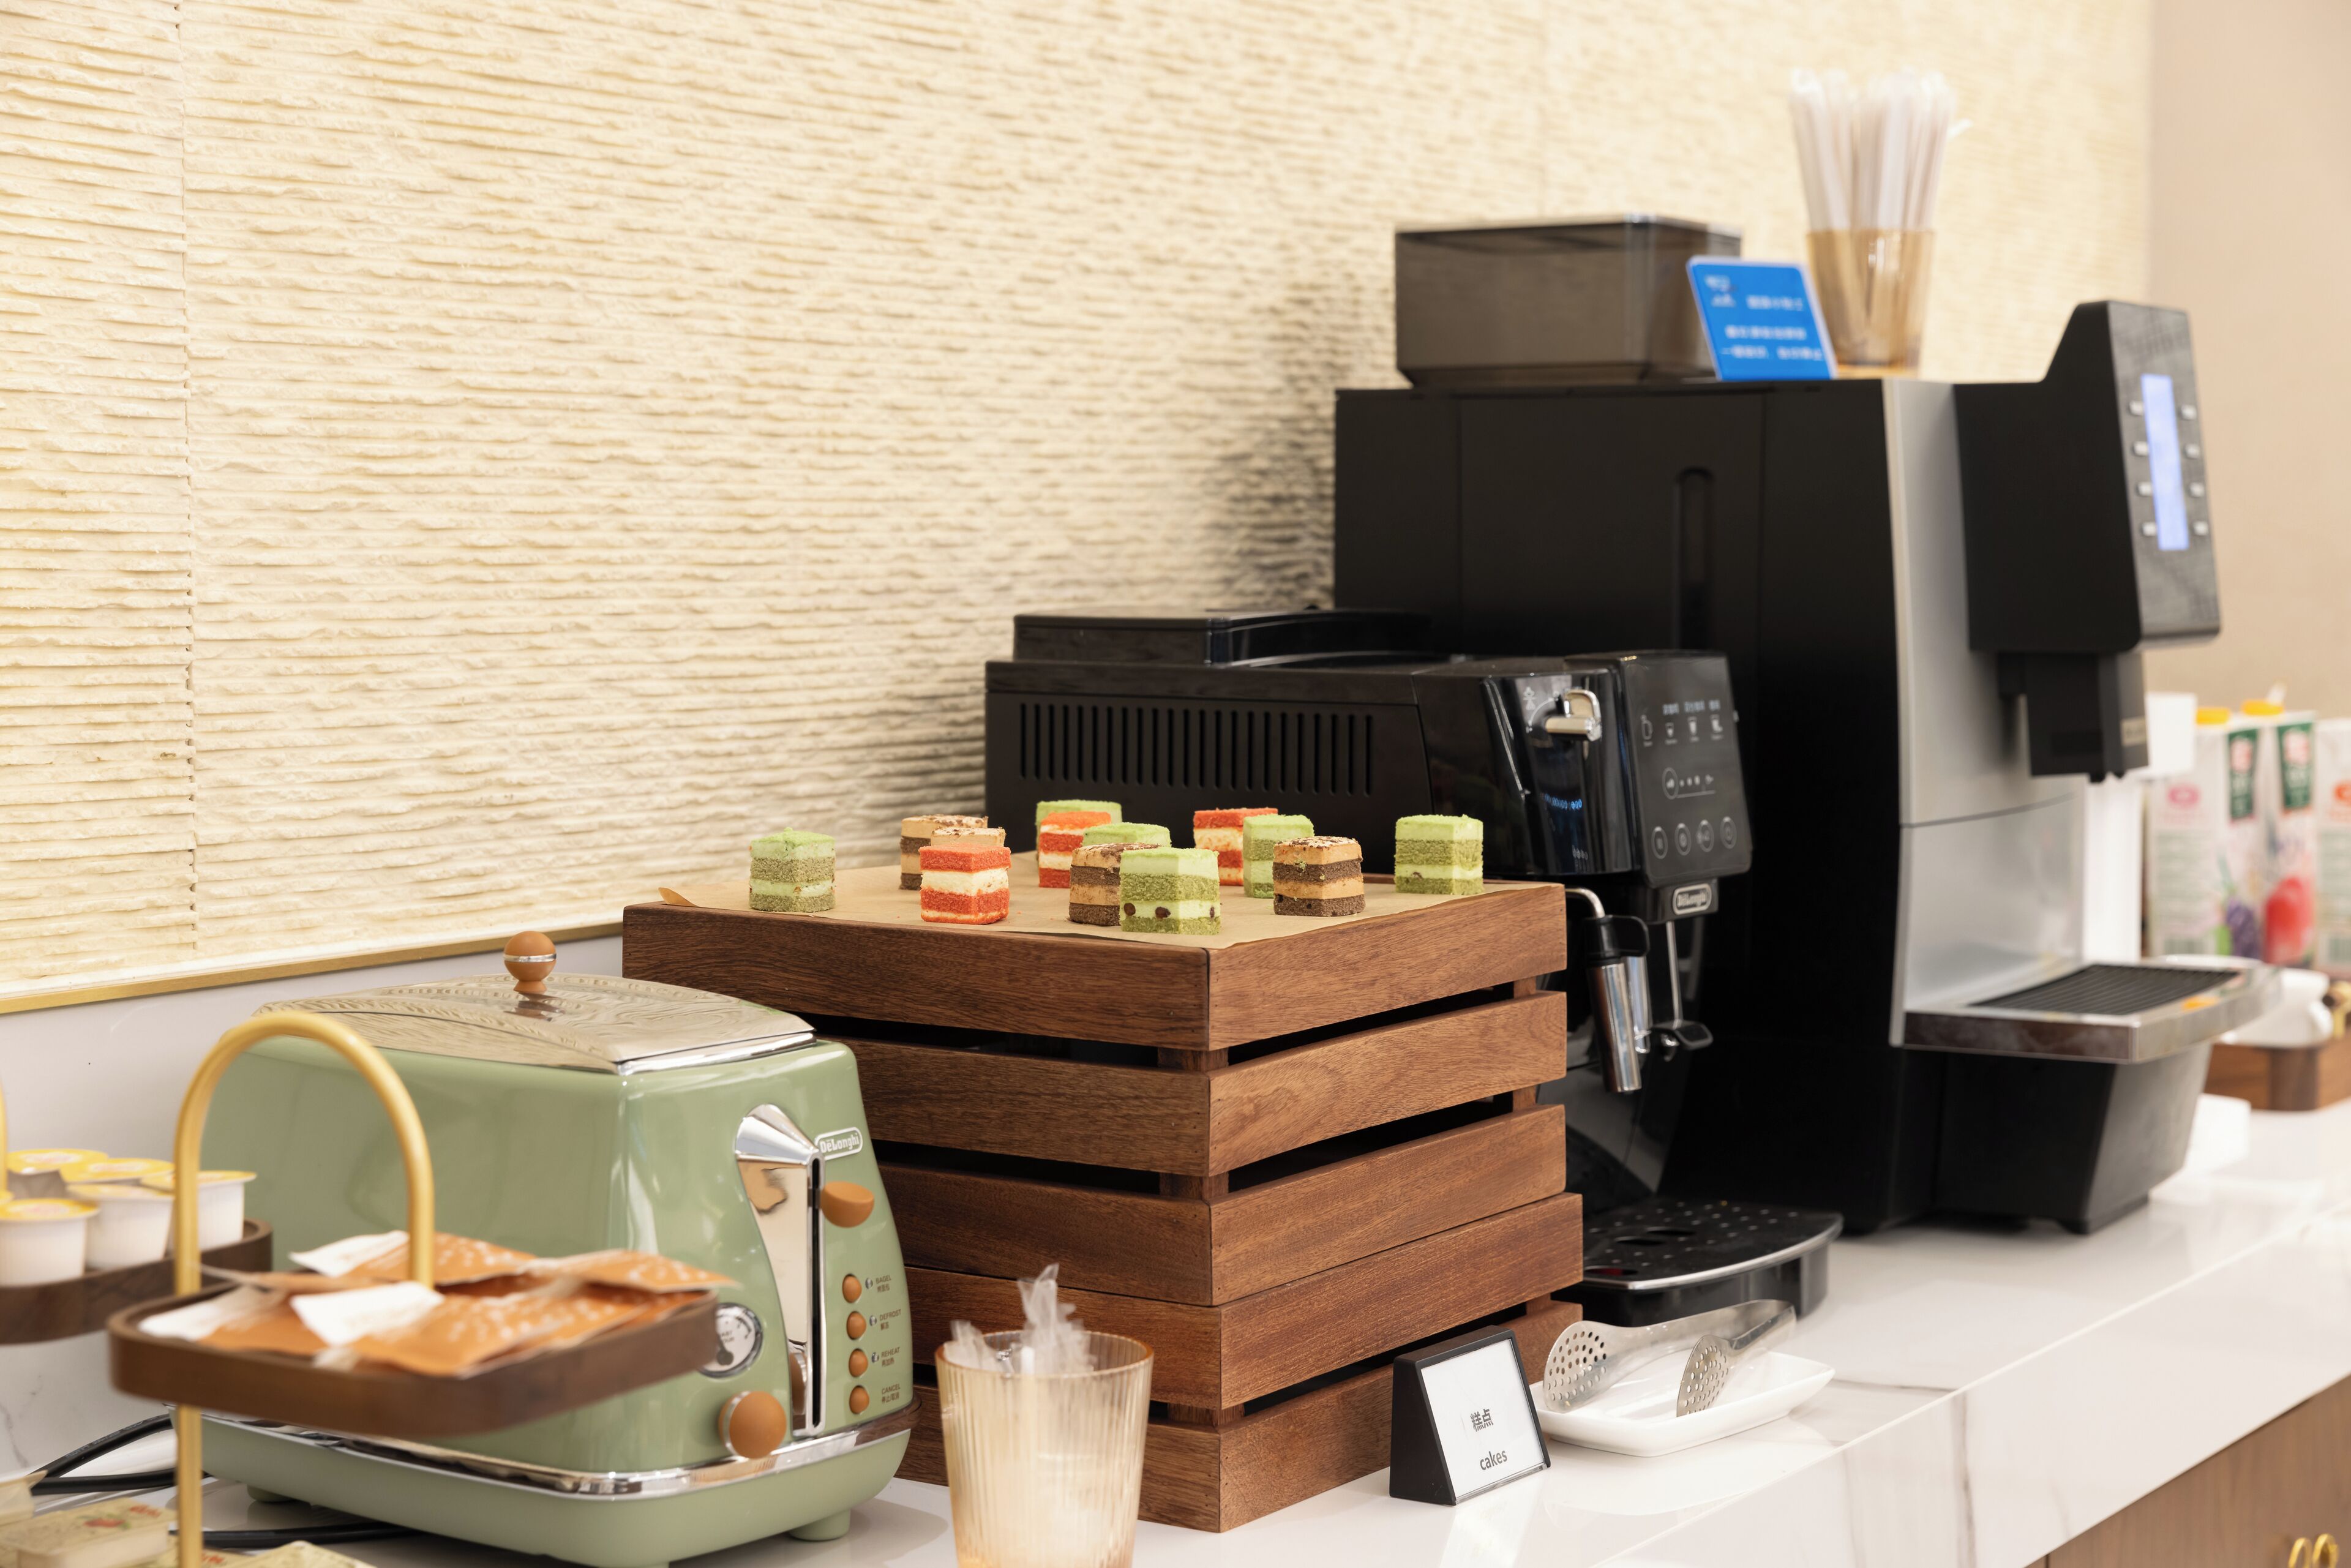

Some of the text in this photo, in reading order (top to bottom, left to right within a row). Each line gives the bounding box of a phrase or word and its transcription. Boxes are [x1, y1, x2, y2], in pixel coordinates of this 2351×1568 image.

[876, 1275, 892, 1284] BAGEL
[879, 1309, 901, 1321] DEFROST
[881, 1346, 901, 1357] REHEAT
[881, 1384, 901, 1395] CANCEL
[1470, 1408, 1494, 1432] 糕点
[1480, 1450, 1507, 1471] cakes
